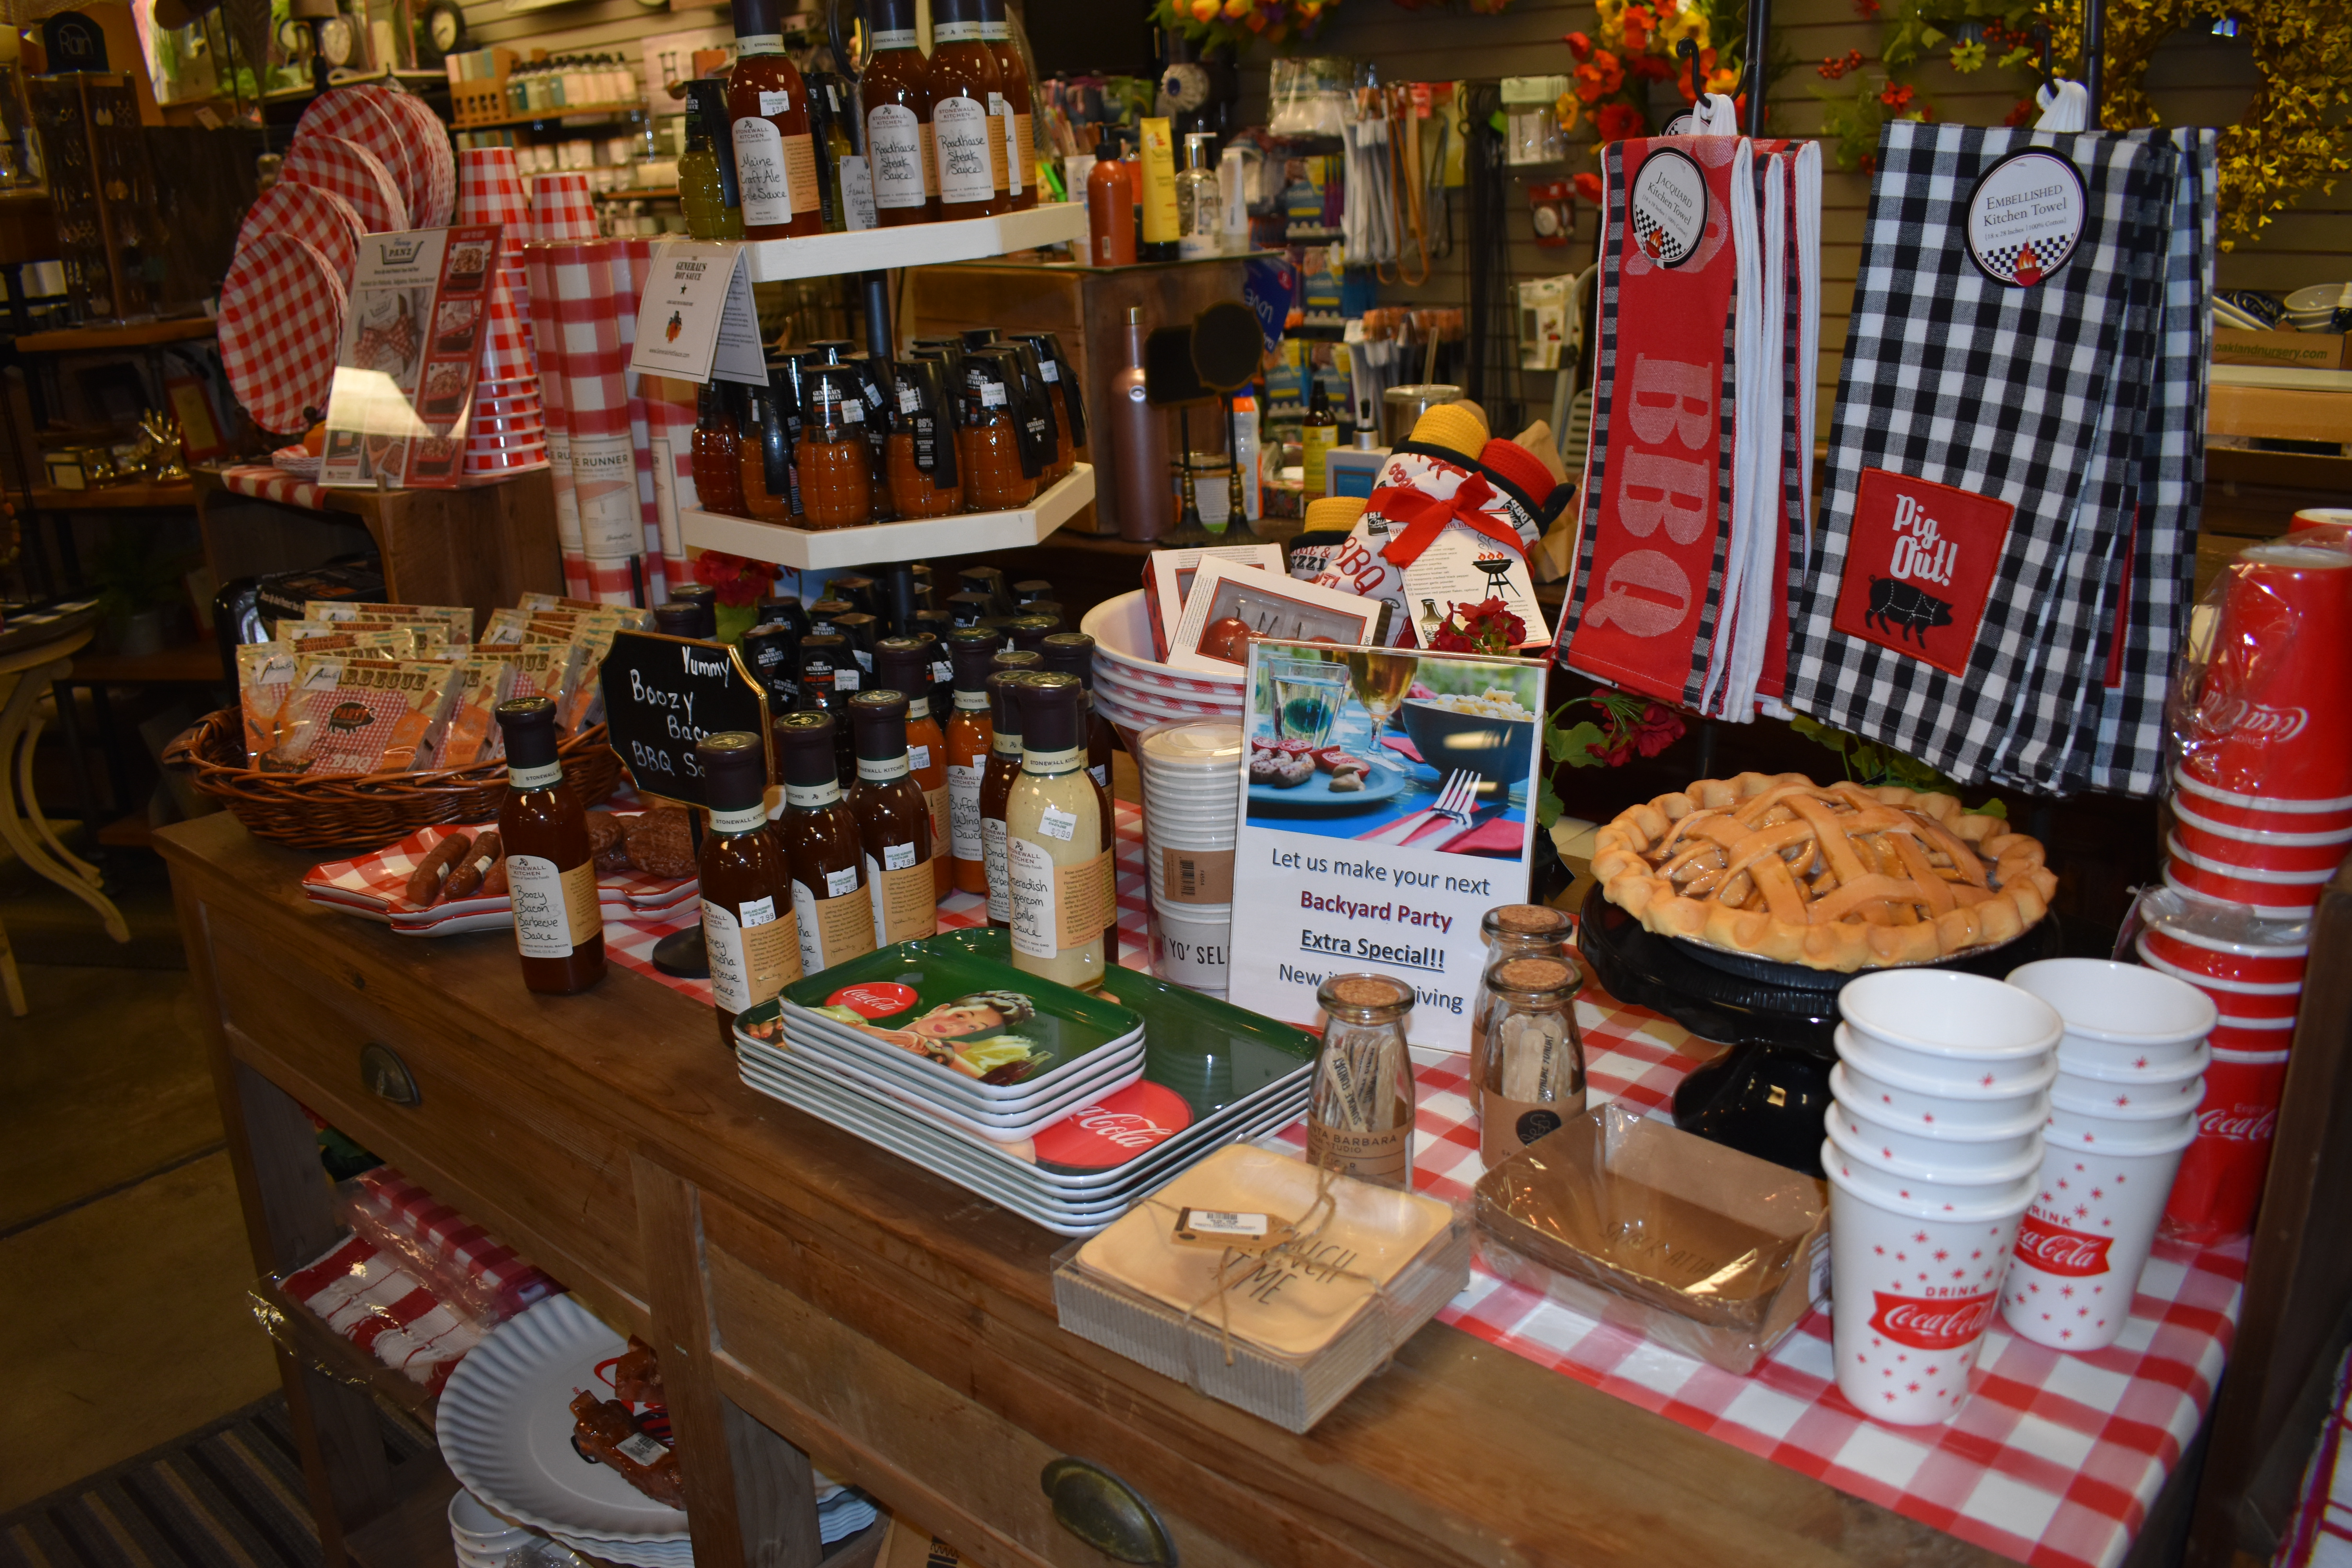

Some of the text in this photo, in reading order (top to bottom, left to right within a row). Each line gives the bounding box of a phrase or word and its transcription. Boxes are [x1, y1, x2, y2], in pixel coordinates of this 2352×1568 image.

[741, 153, 773, 168] Maine
[881, 157, 909, 167] Steak
[948, 151, 978, 162] Steak
[763, 169, 780, 183] Ale
[884, 170, 912, 180] Sauce
[951, 164, 981, 174] Sauce
[758, 189, 787, 198] Sauce
[1656, 172, 1692, 208] JACQUARD
[1986, 185, 2062, 210] EMBELLISHED
[1648, 182, 1691, 225] Kitchen Towel
[1984, 197, 2067, 227] Kitchen Towel
[2214, 342, 2327, 360] oaklandnursery.com
[917, 418, 933, 427] 86%
[583, 454, 628, 466] RUNNER
[1585, 352, 1713, 638] BBQ
[1892, 494, 1940, 549] Pig
[1889, 535, 1958, 586] Out!
[682, 646, 730, 688] Yummy
[337, 669, 428, 690] RBECUE
[630, 669, 694, 724] Boozy
[334, 707, 368, 721] PARTY
[667, 715, 718, 741] Baco
[329, 754, 372, 769] BBQ
[632, 740, 675, 777] BBQ
[526, 772, 556, 780] STONEWALL
[884, 764, 904, 772] KITCHEN
[949, 794, 980, 812] Buffal
[955, 812, 980, 832] Wing
[983, 827, 1006, 836] STONEWA
[1051, 828, 1071, 838] $7.99
[985, 844, 1007, 859] Smok
[1010, 854, 1034, 864] KITCHEN
[988, 860, 1008, 875] Mapl
[1272, 848, 1490, 896] Let us make your next
[986, 870, 1008, 886] Barbe
[514, 885, 547, 905] Boozy
[990, 886, 1009, 900] Sauc
[515, 899, 550, 913] Bacon
[1015, 905, 1034, 922] Grille
[1300, 890, 1453, 934] Backyard Party
[515, 913, 558, 927] Barbecue
[1012, 918, 1041, 937] Sauce
[521, 927, 558, 940] Sauce
[1169, 941, 1230, 965] YO' SEL
[1301, 929, 1445, 968] Extra Special!!
[1279, 963, 1322, 986] New
[842, 988, 906, 1012] Coca-Cola
[1076, 1104, 1174, 1148] a-Cola
[1326, 1141, 1361, 1153] STUDIO
[1334, 1134, 1397, 1147] BARBARA
[2017, 1225, 2102, 1267] ca-Cola
[1925, 1285, 1980, 1298] DRINK
[1884, 1299, 1994, 1336] Coca-Cola
